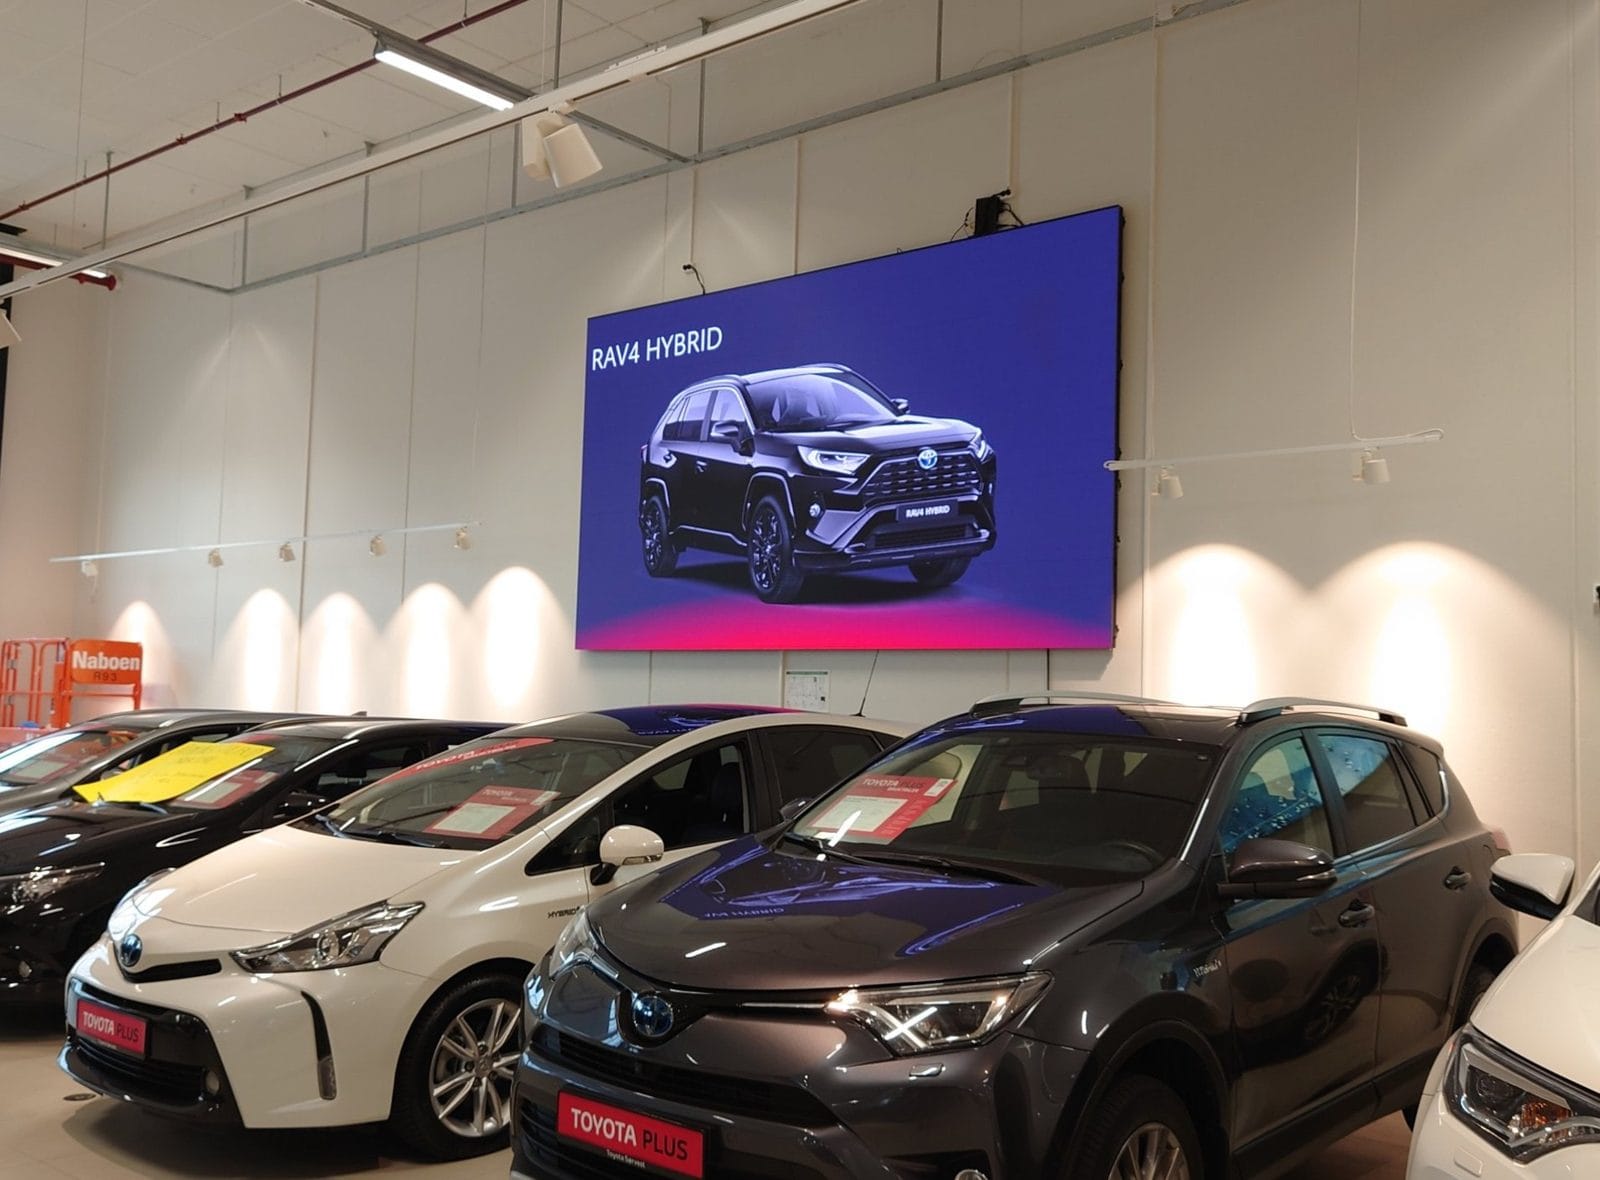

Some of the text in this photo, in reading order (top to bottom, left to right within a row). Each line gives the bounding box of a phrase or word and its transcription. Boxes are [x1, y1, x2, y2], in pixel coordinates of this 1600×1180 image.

[592, 326, 723, 371] RAV4 HYBRID
[72, 650, 140, 671] Naboen
[83, 1011, 139, 1042] TOYOTA PLUS
[571, 1107, 688, 1161] TOYOTA PLUS
